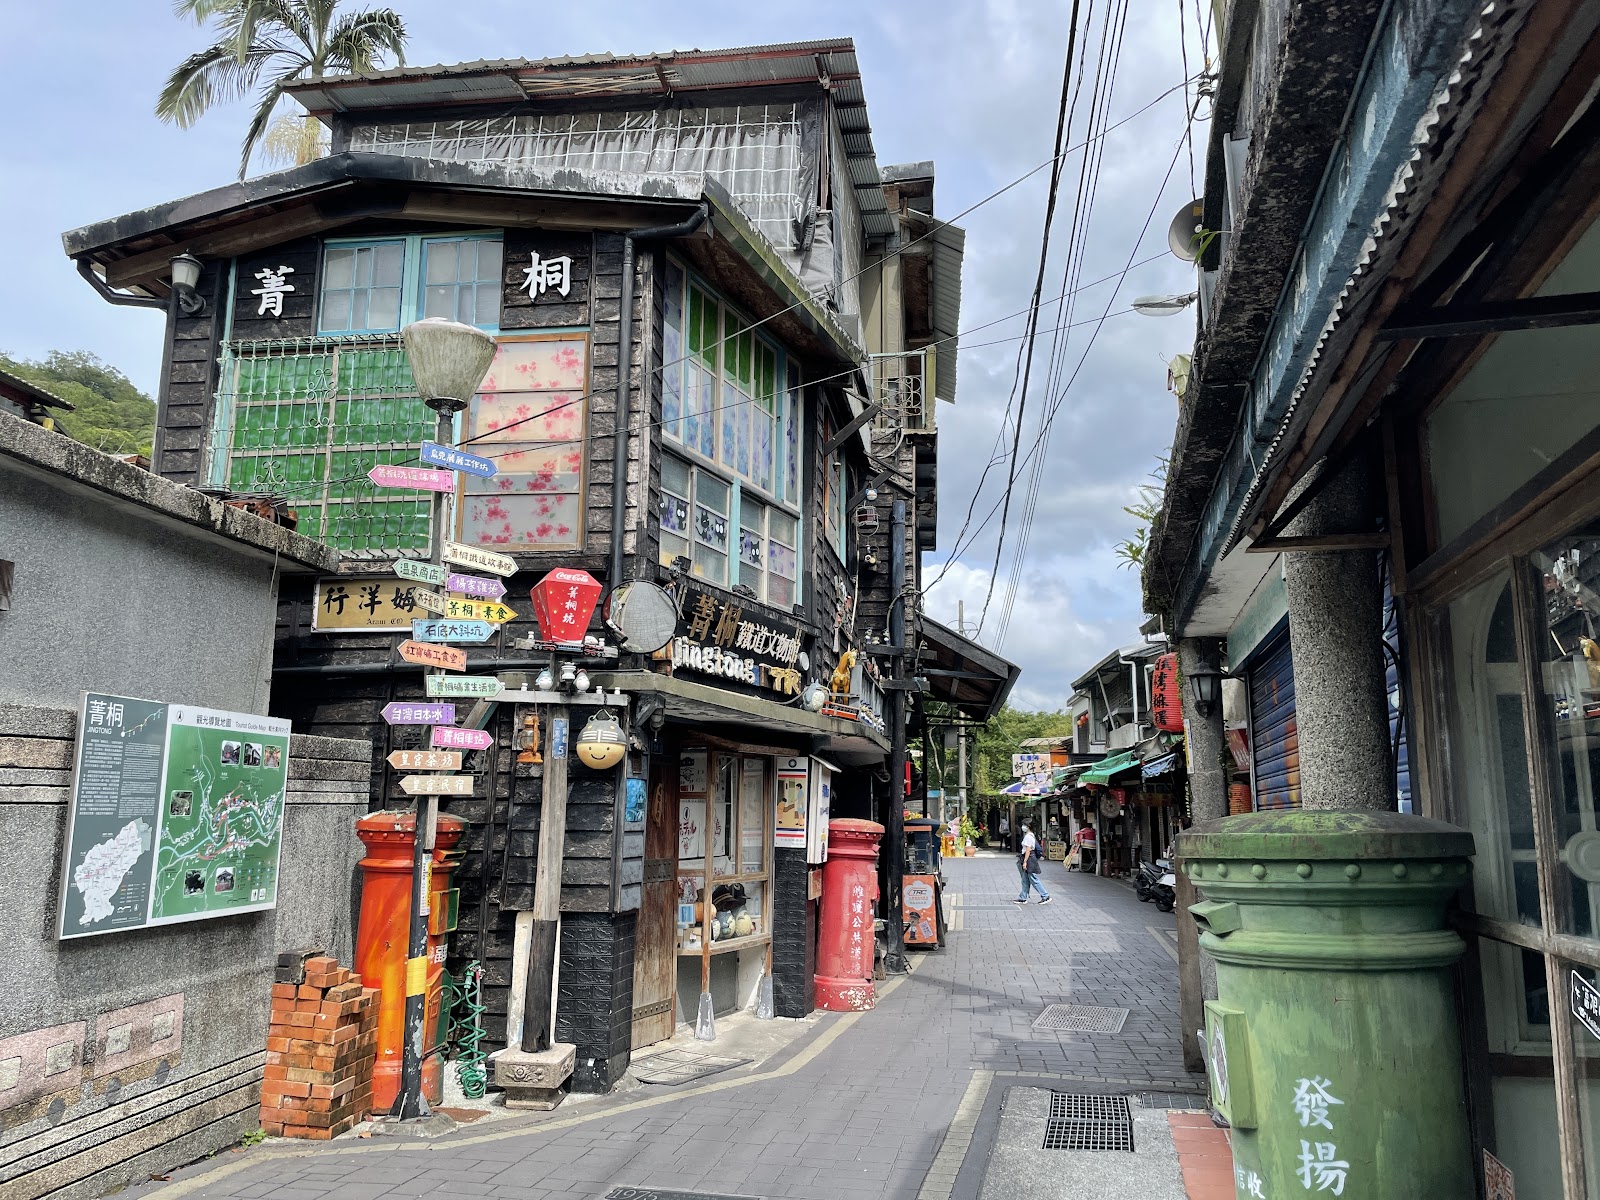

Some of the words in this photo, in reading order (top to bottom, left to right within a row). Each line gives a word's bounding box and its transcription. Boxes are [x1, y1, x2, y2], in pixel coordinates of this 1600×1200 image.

[251, 265, 295, 317] 菁
[520, 251, 572, 300] 桐
[448, 601, 473, 617] 菁桐
[483, 606, 508, 620] 素食
[562, 586, 579, 625] 菁桐坑
[425, 623, 484, 638] 石底大斜坑
[88, 699, 124, 728] 菁桐
[196, 713, 232, 728] 觀光導覽地圖
[391, 707, 443, 721] 台灣日本冰
[87, 726, 112, 735] JINGTONG
[235, 721, 247, 729] Tourist
[443, 730, 485, 744] 菁桐車站
[400, 752, 453, 767] 皇宮茶坊
[411, 778, 465, 792] 皇宮民宿
[1291, 1074, 1350, 1196] 發揚
